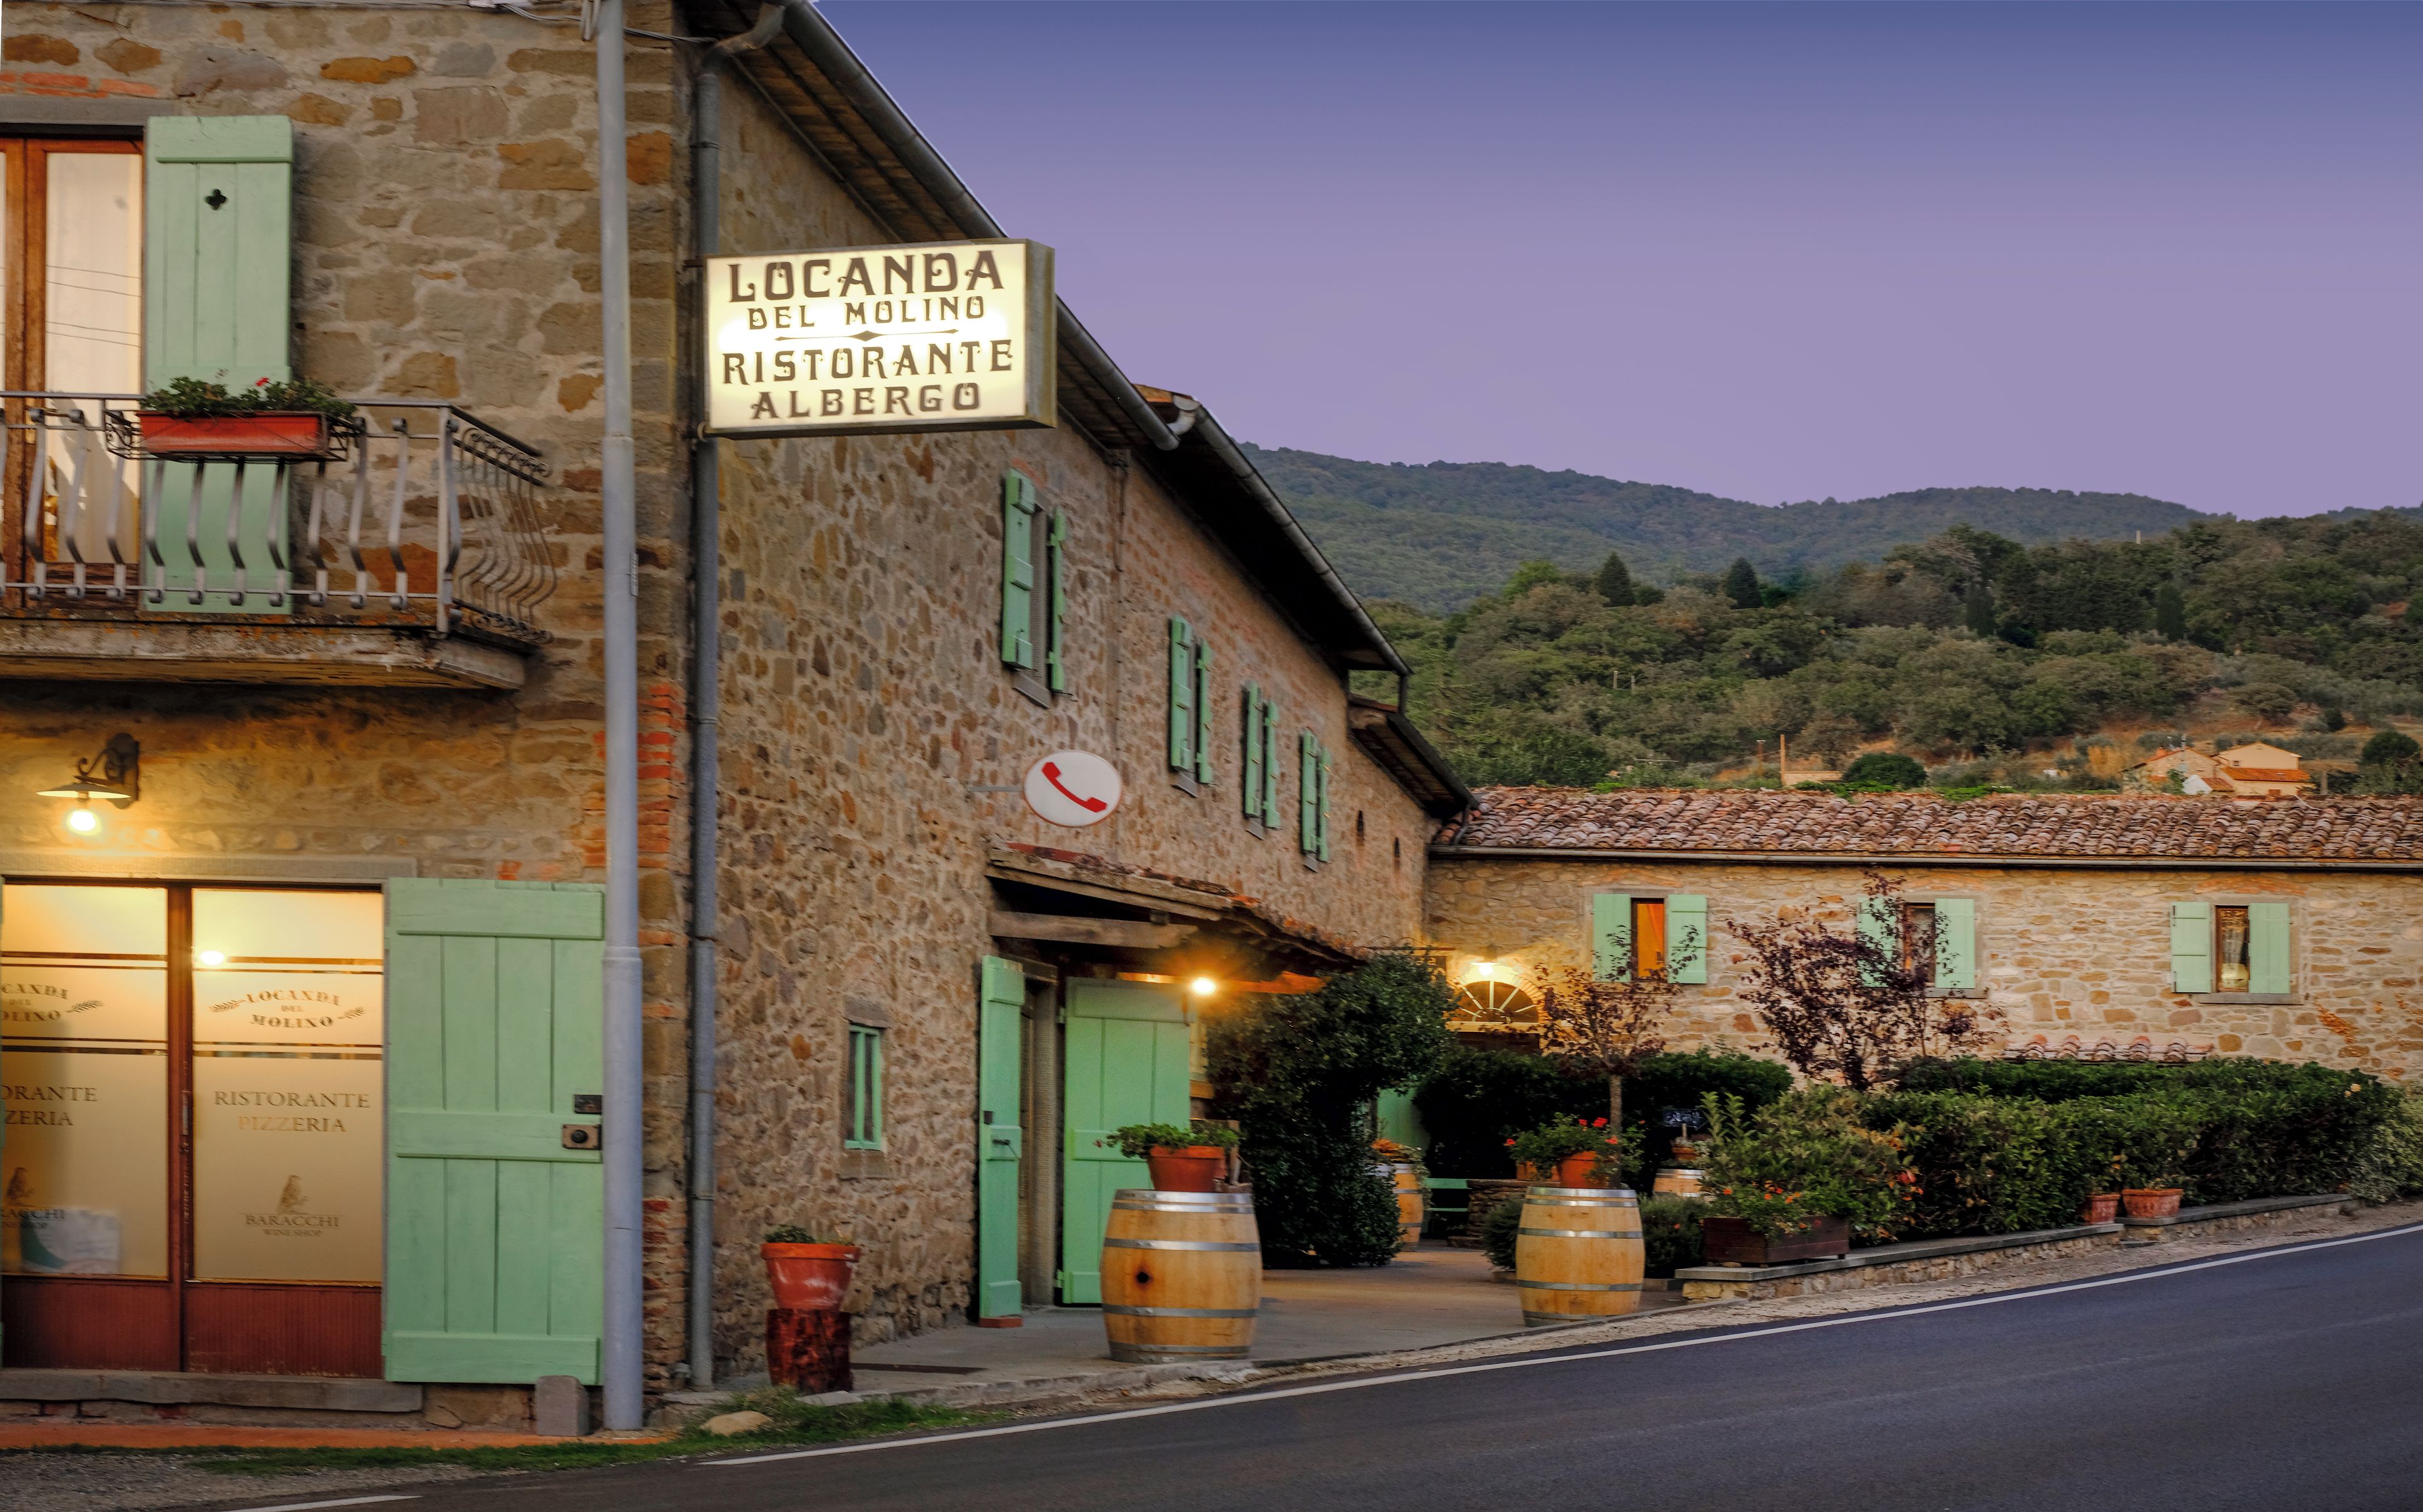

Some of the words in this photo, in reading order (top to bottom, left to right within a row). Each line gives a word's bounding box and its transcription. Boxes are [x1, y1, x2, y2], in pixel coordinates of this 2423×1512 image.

[728, 250, 1005, 302] LOCANDA
[747, 305, 815, 331] DEL
[845, 295, 984, 325] MOLINO
[722, 339, 1013, 386] RISTORANTE
[750, 382, 980, 419] ALBERGO
[245, 990, 341, 1006] LOCANDA
[249, 1014, 334, 1028] MOLINO
[214, 1091, 370, 1108] RISTORANTE
[237, 1116, 347, 1132] PIZZERIA
[245, 1215, 339, 1227] BARACCHI
